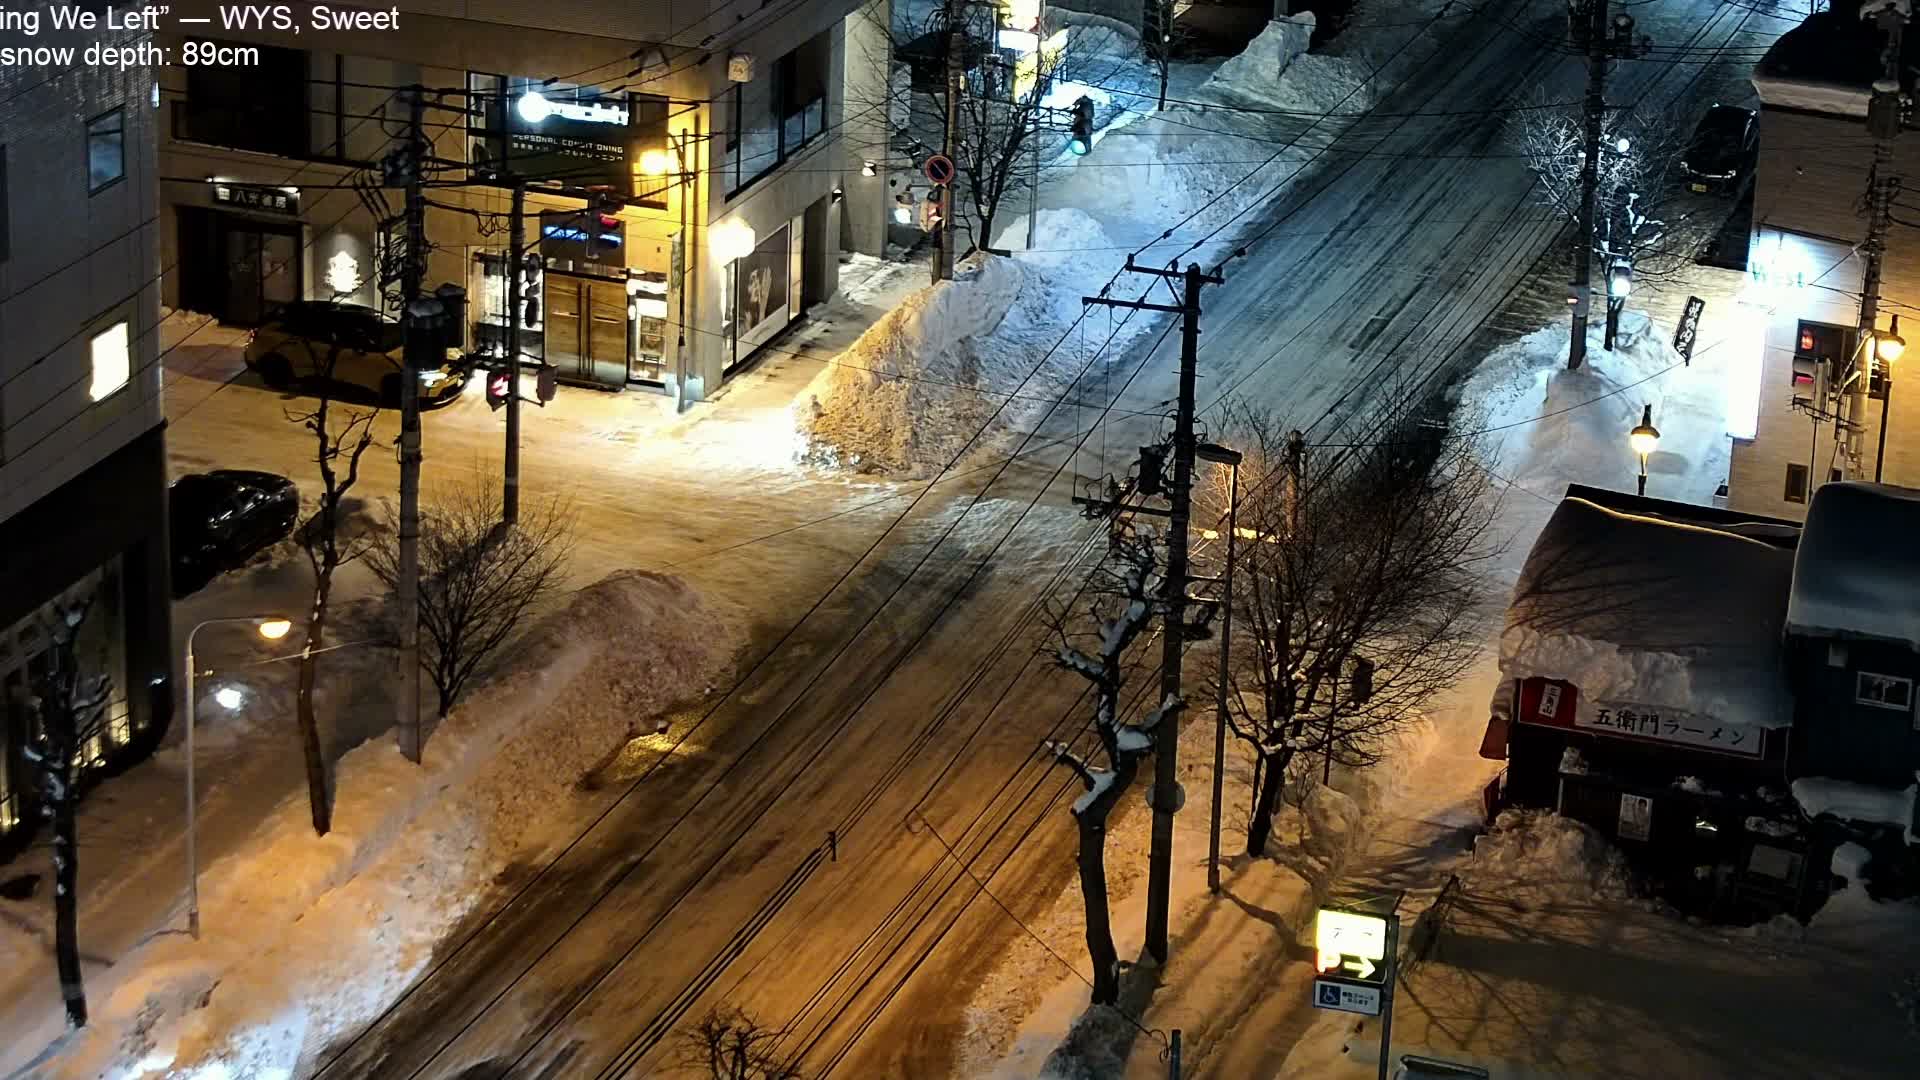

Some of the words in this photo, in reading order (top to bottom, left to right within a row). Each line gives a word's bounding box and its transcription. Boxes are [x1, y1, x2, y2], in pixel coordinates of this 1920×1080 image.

[1593, 708, 1746, 746] 五衛門ラーメン
